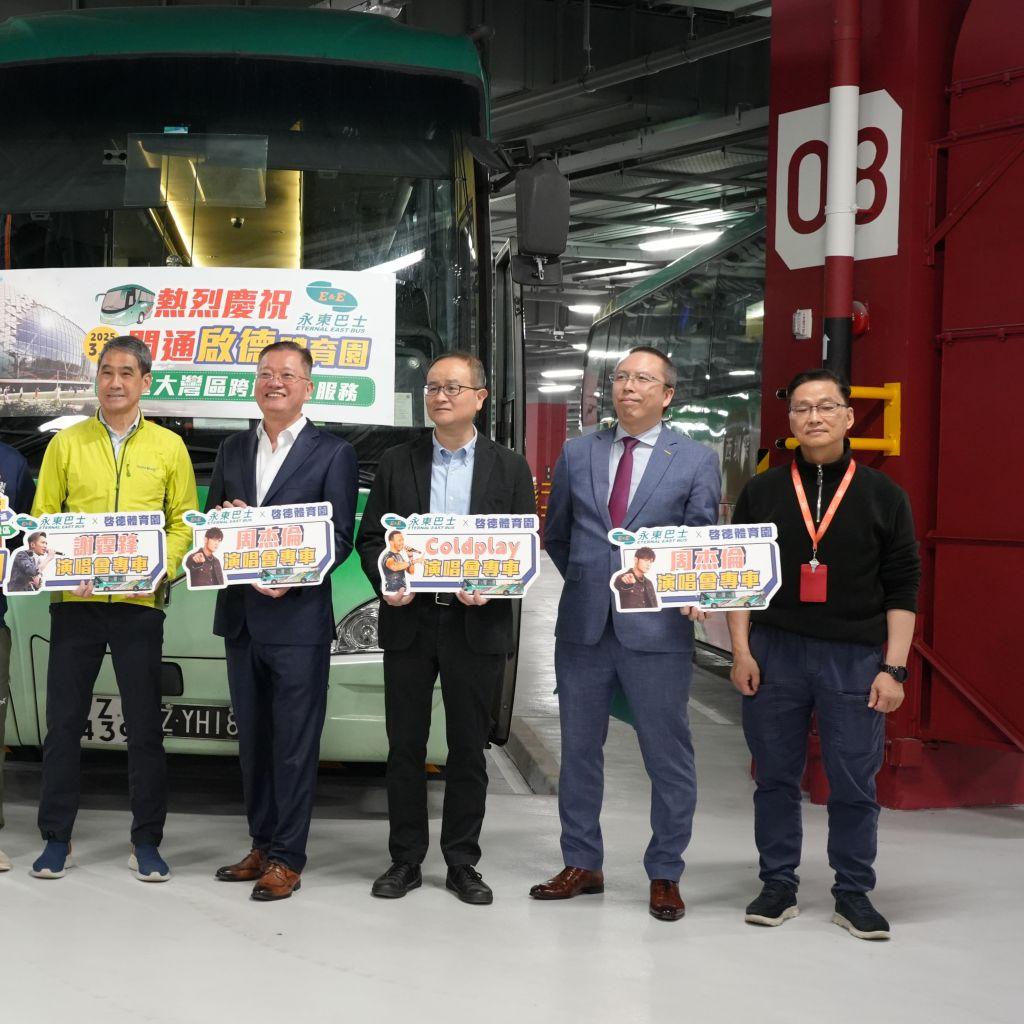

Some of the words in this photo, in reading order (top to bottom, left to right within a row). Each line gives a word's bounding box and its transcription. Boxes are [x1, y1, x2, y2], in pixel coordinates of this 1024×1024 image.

[154, 288, 292, 320] 熱烈慶祝
[298, 313, 367, 328] 永東巴士
[41, 516, 86, 524] 永東巴士
[210, 510, 253, 520] 永東巴士
[409, 517, 456, 526] 永東巴士
[638, 529, 688, 539] 永東巴士
[425, 537, 520, 560] Coldplay
[56, 556, 149, 576] 演唱會專車
[224, 547, 316, 570] 演唱會專車
[423, 559, 520, 577] 演唱會專車
[657, 570, 760, 592] 演唱會專車
